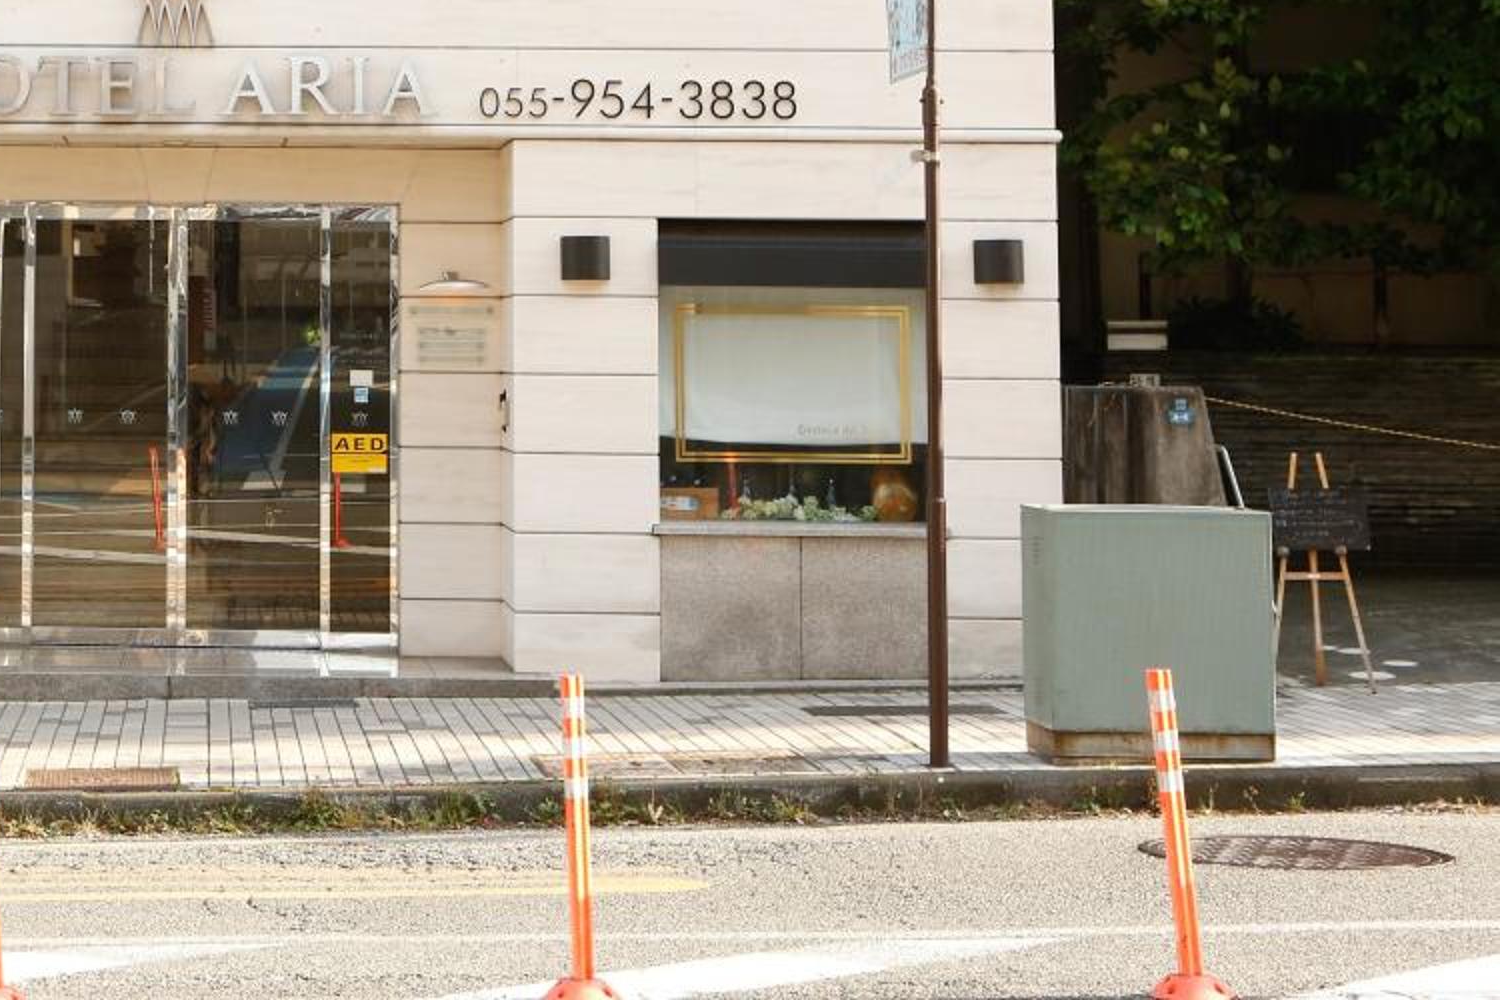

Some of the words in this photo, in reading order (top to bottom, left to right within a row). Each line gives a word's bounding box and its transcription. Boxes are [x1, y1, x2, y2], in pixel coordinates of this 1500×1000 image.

[219, 55, 436, 117] ARIA
[478, 78, 798, 120] 055-954-3838
[334, 437, 385, 451] AED
